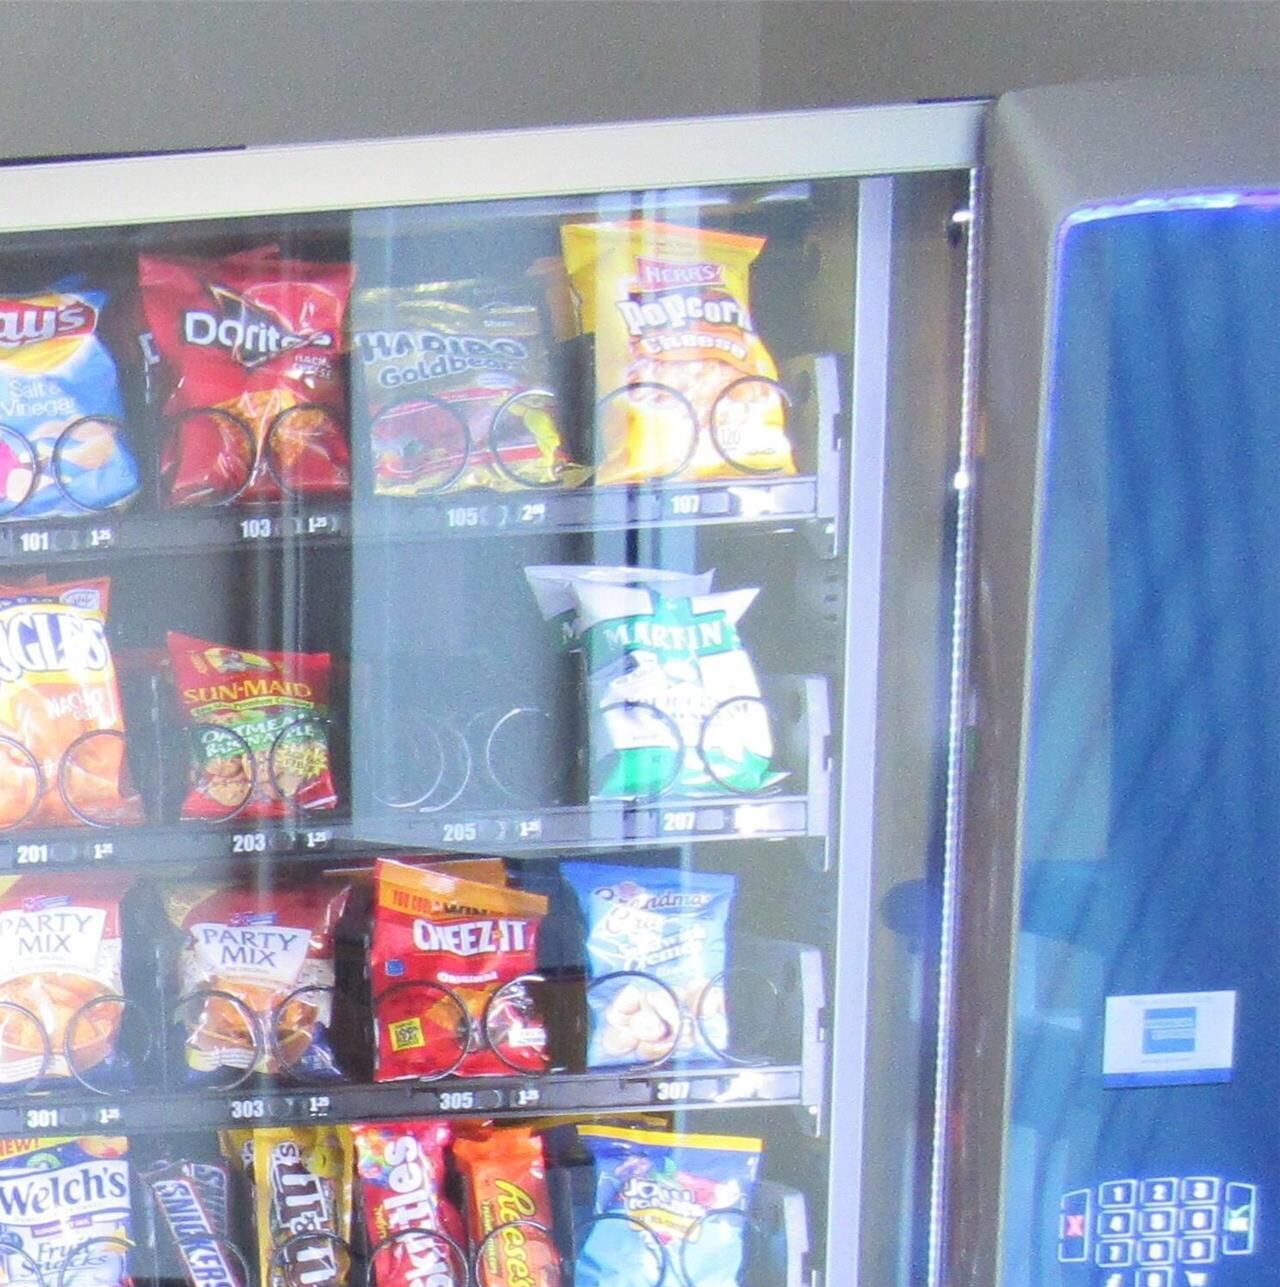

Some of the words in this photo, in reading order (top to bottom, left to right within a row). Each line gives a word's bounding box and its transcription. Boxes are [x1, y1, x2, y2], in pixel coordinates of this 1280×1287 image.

[616, 295, 754, 336] Popcorn
[671, 495, 700, 514] 107
[447, 508, 477, 526] 105
[241, 519, 270, 537] 103
[20, 532, 48, 551] 101
[183, 680, 312, 703] SUN-MAID
[663, 811, 694, 832] 207
[443, 823, 475, 841] 205
[233, 834, 265, 852] 203
[17, 844, 48, 864] 201
[0, 913, 93, 937] PARTY
[18, 934, 72, 956] MIX
[202, 927, 298, 951] PARTY
[220, 945, 276, 968] MIX
[657, 1081, 690, 1100] 307
[231, 1100, 265, 1119] 303
[440, 1091, 472, 1110] 305
[27, 1109, 58, 1128] 301
